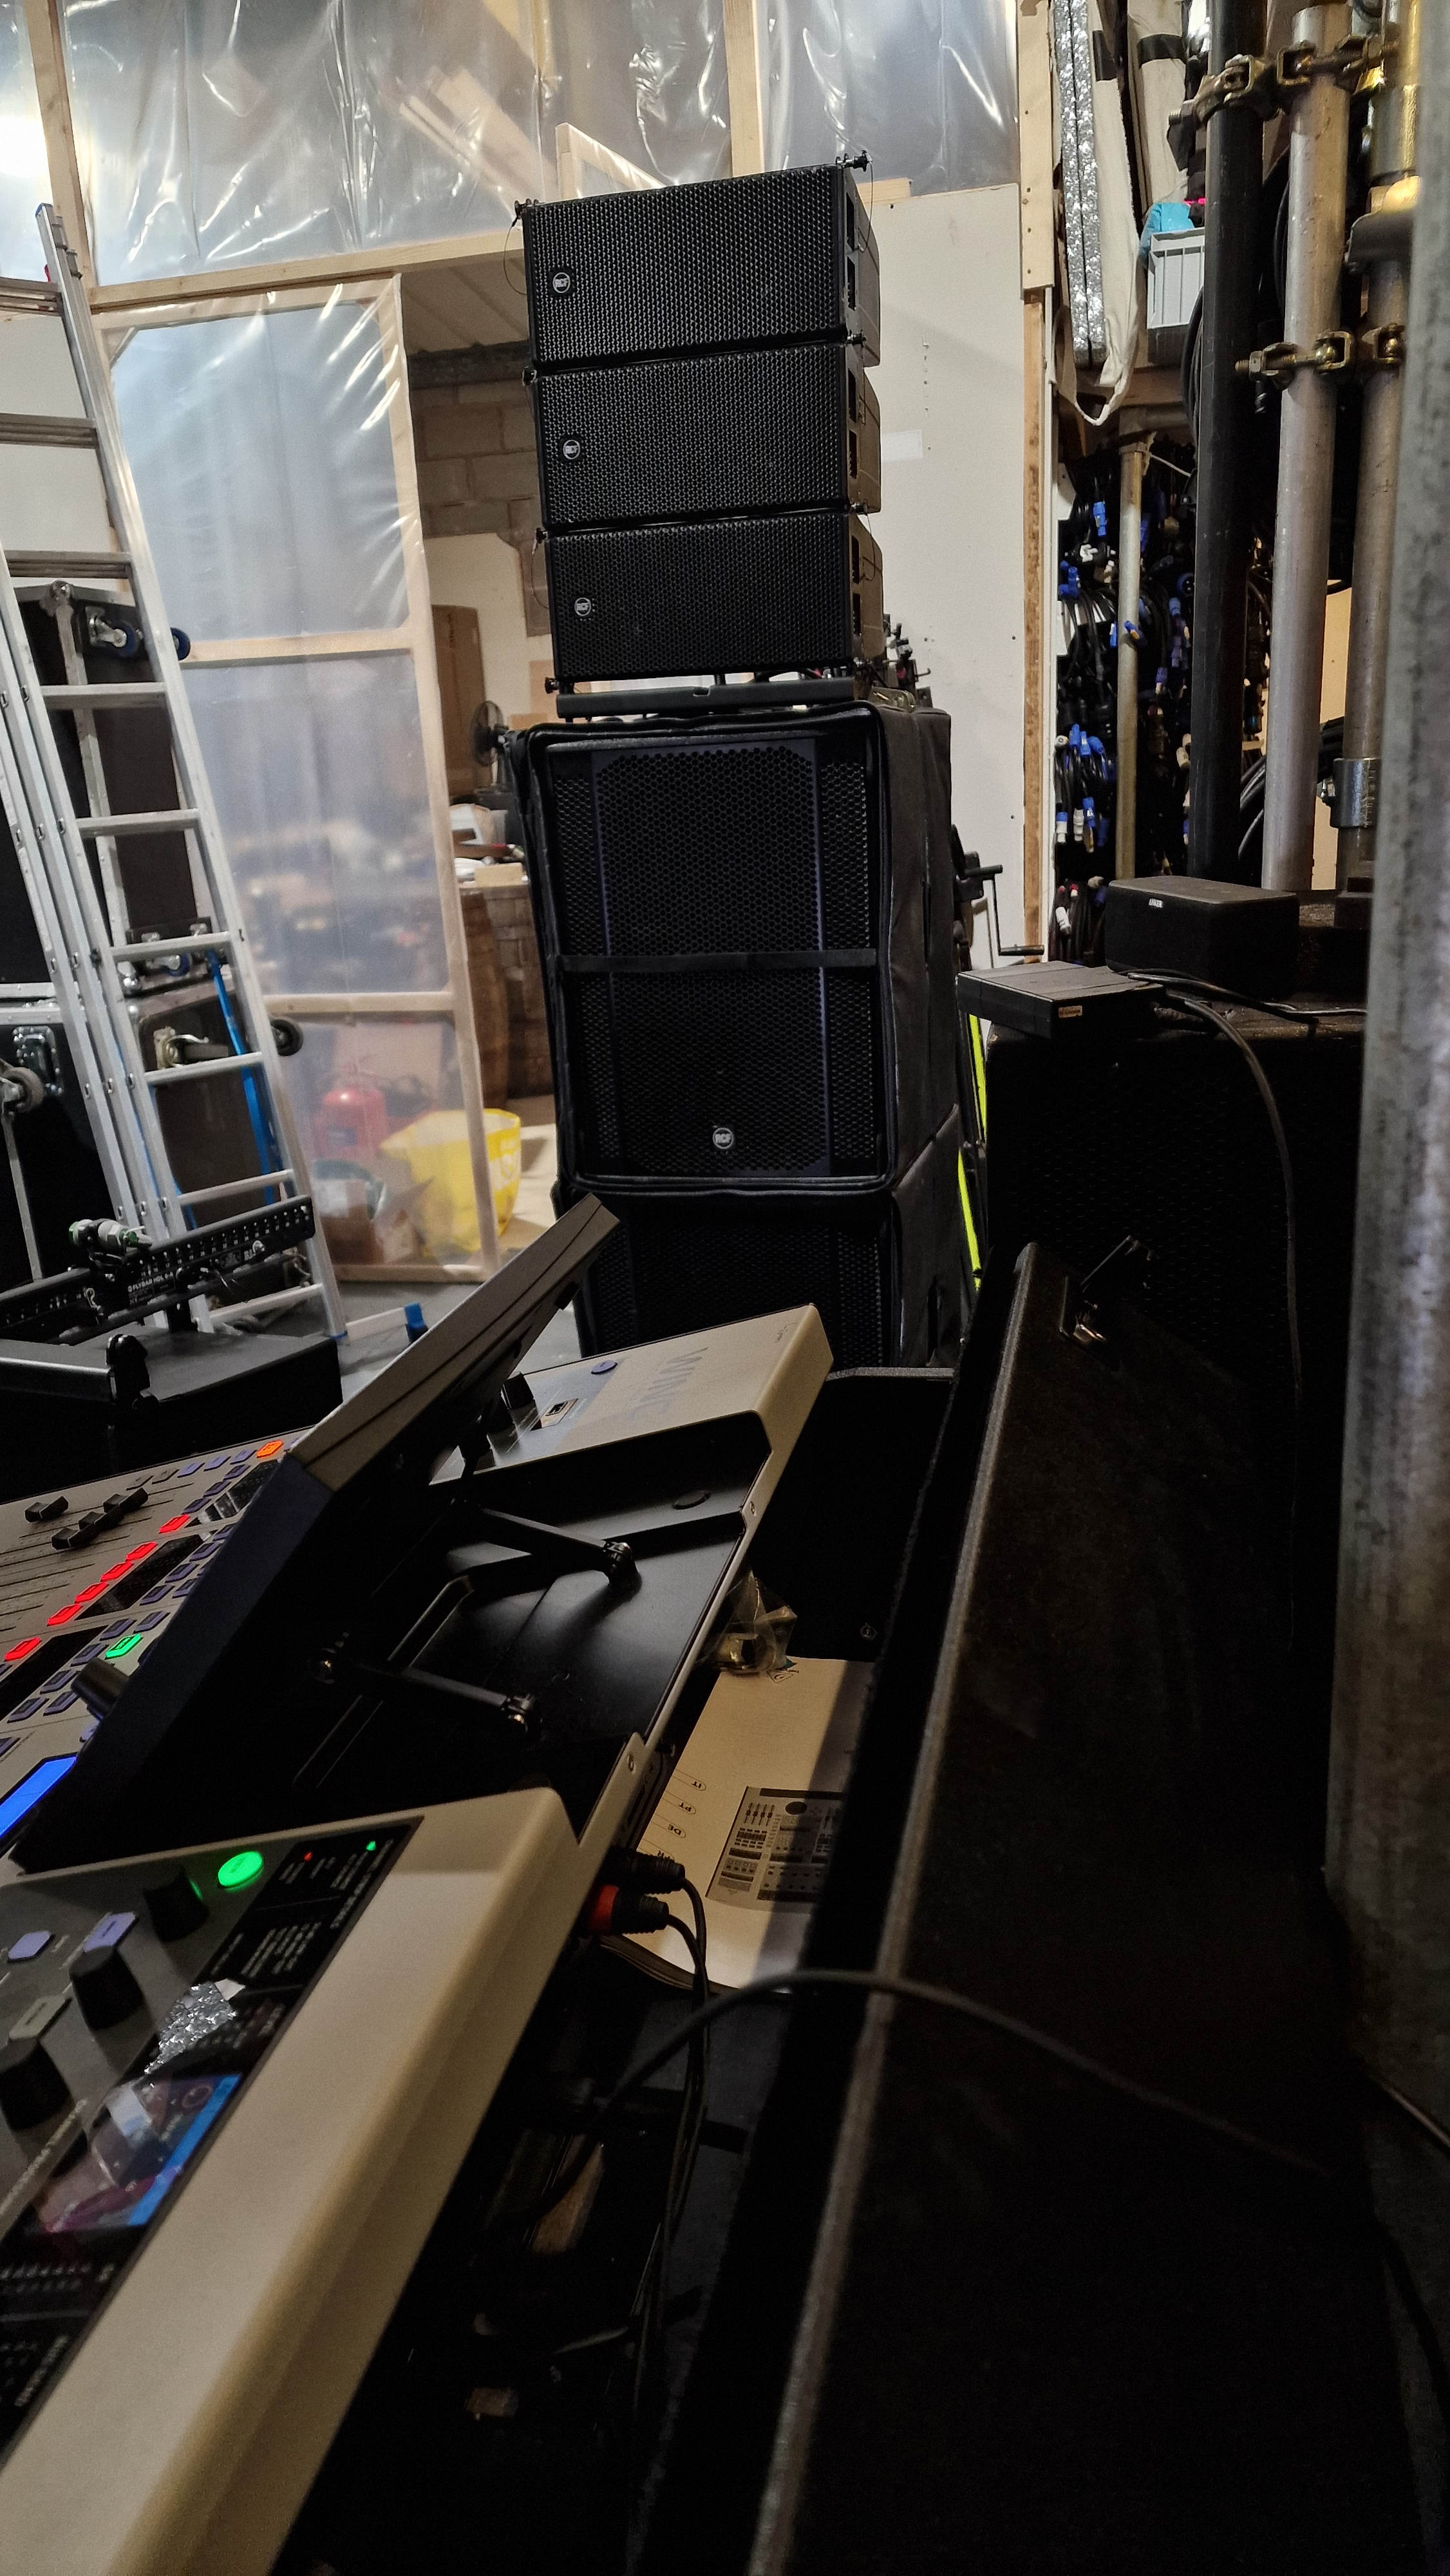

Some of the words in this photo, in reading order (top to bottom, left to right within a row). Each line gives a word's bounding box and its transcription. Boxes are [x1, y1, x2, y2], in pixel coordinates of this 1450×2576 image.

[692, 1781, 702, 1789] IT
[678, 1802, 692, 1812] PT
[667, 1824, 682, 1836] DE
